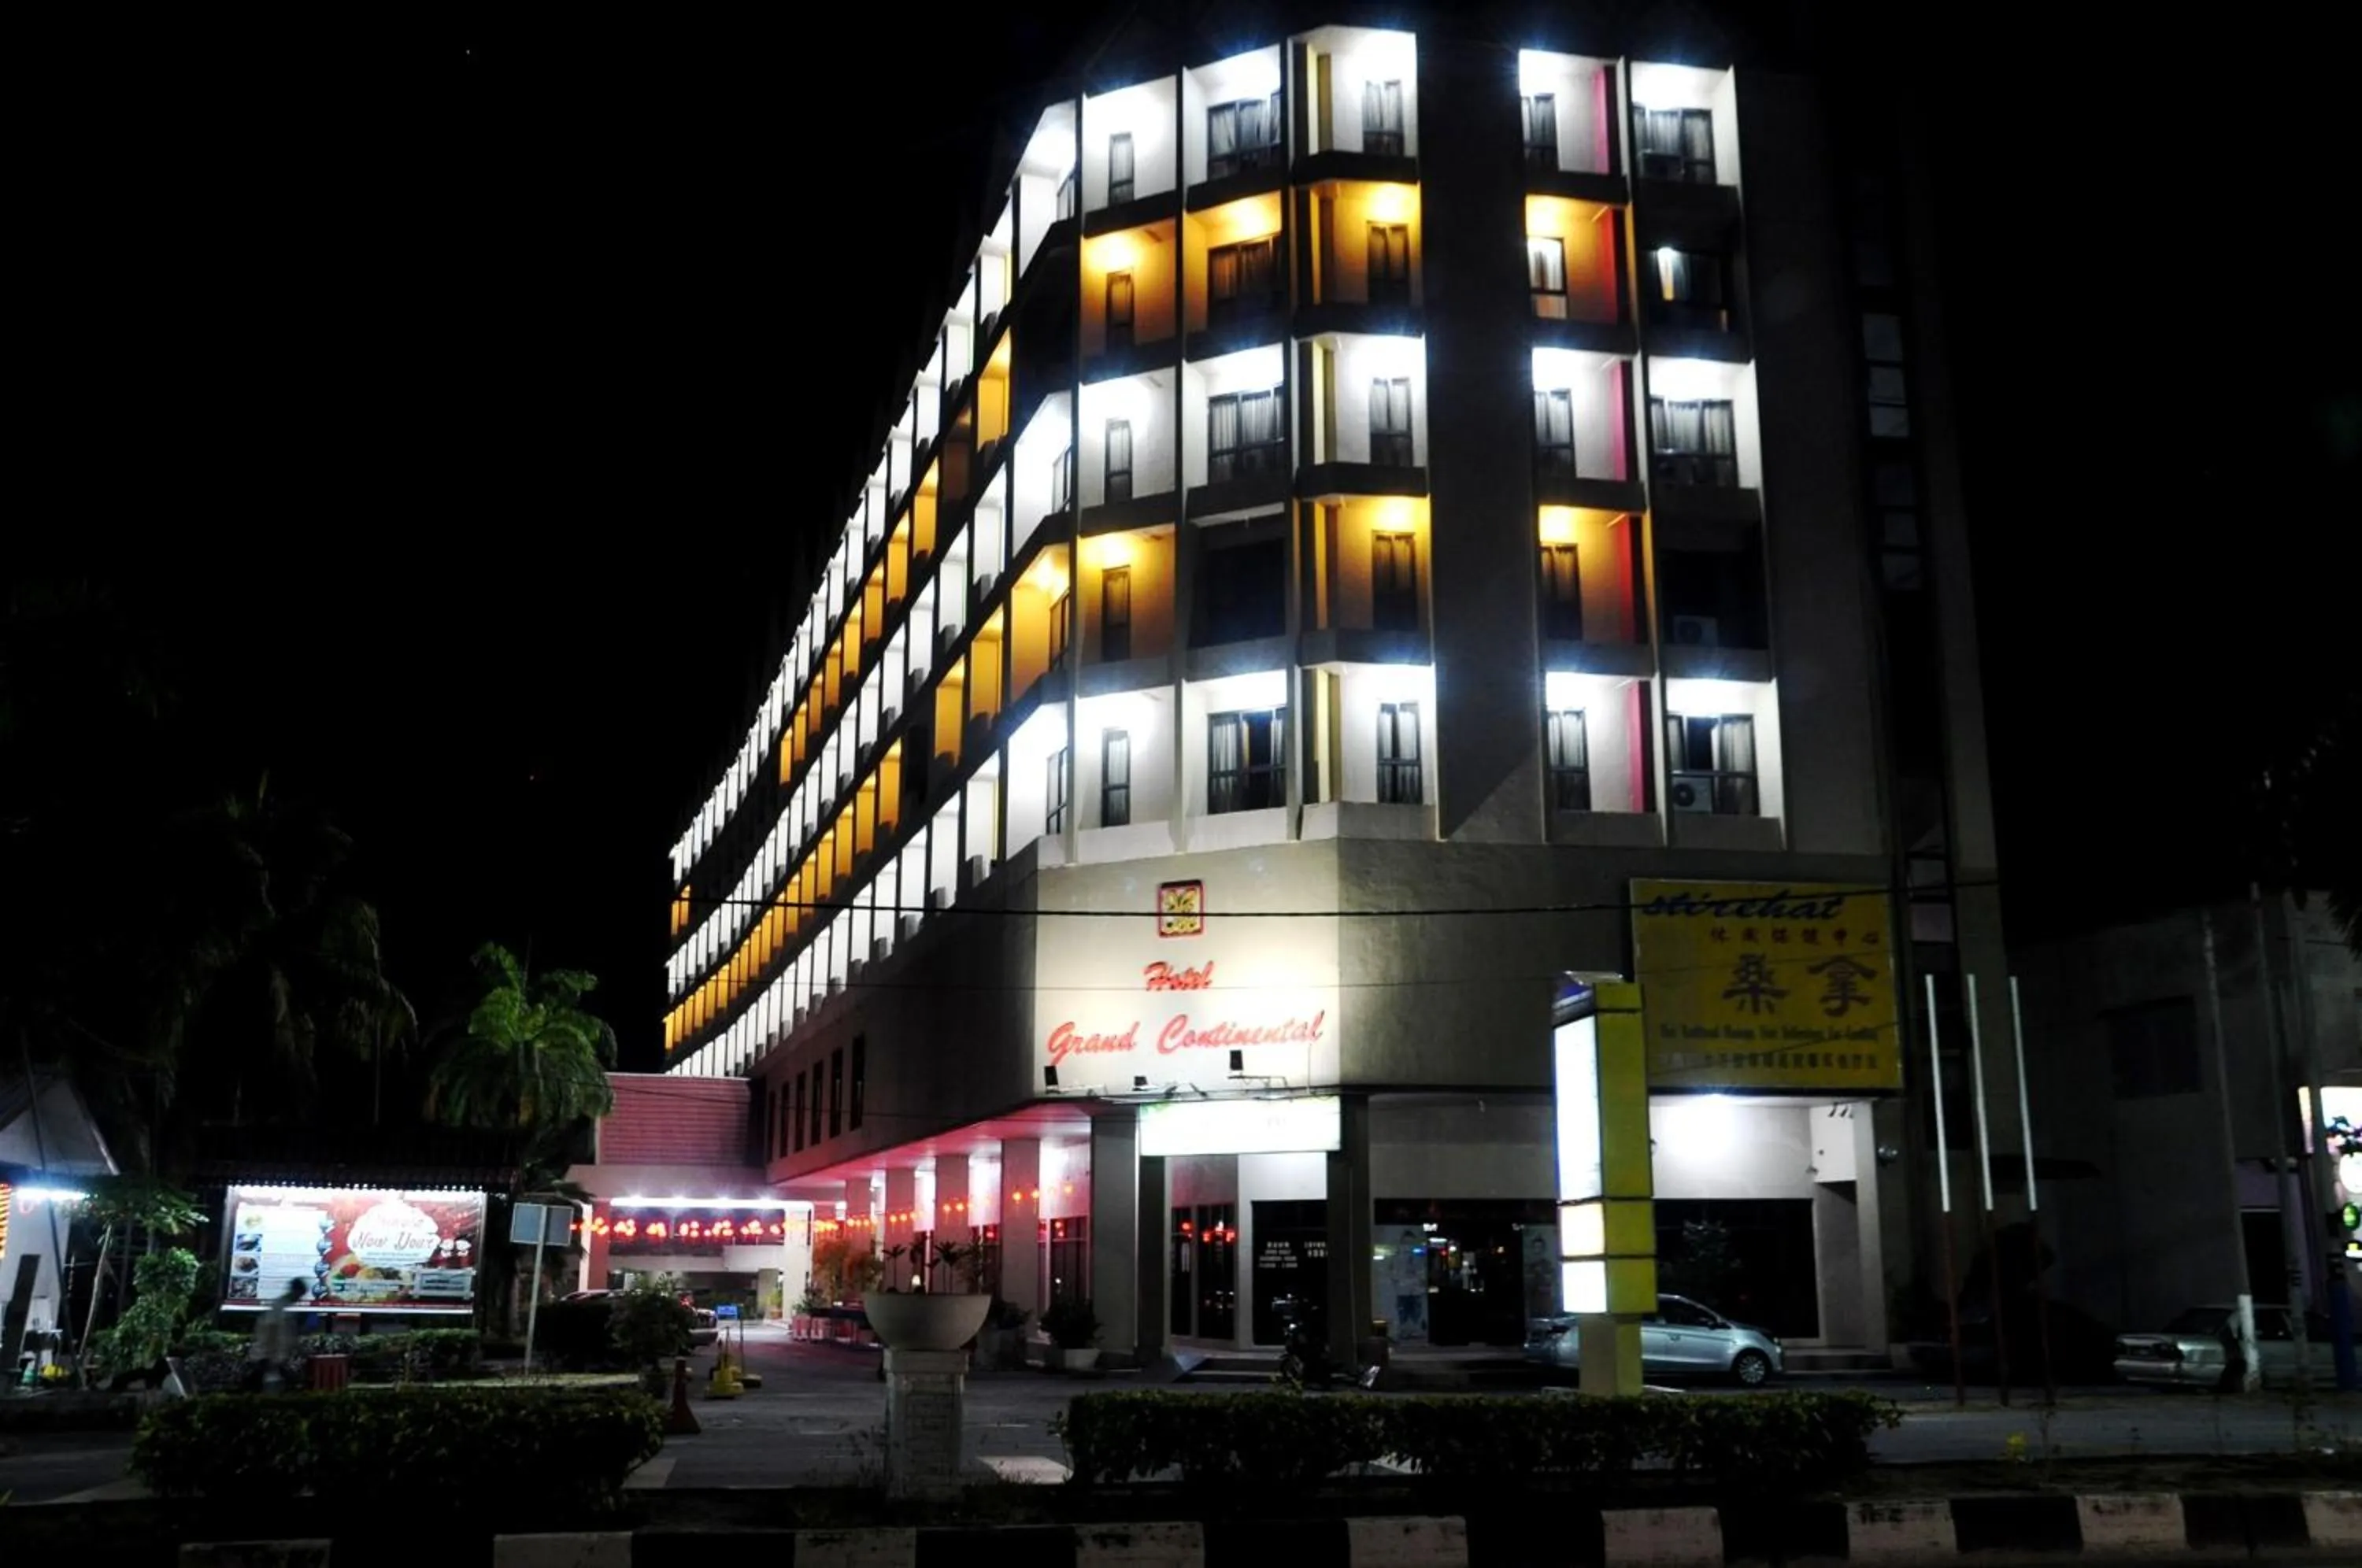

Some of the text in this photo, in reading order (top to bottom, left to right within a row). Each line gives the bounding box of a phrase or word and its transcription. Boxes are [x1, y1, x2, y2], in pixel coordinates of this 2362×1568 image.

[1143, 961, 1214, 991] Hotel
[1722, 953, 1879, 1017] 桑拿
[1046, 1010, 1325, 1067] Grand Continental
